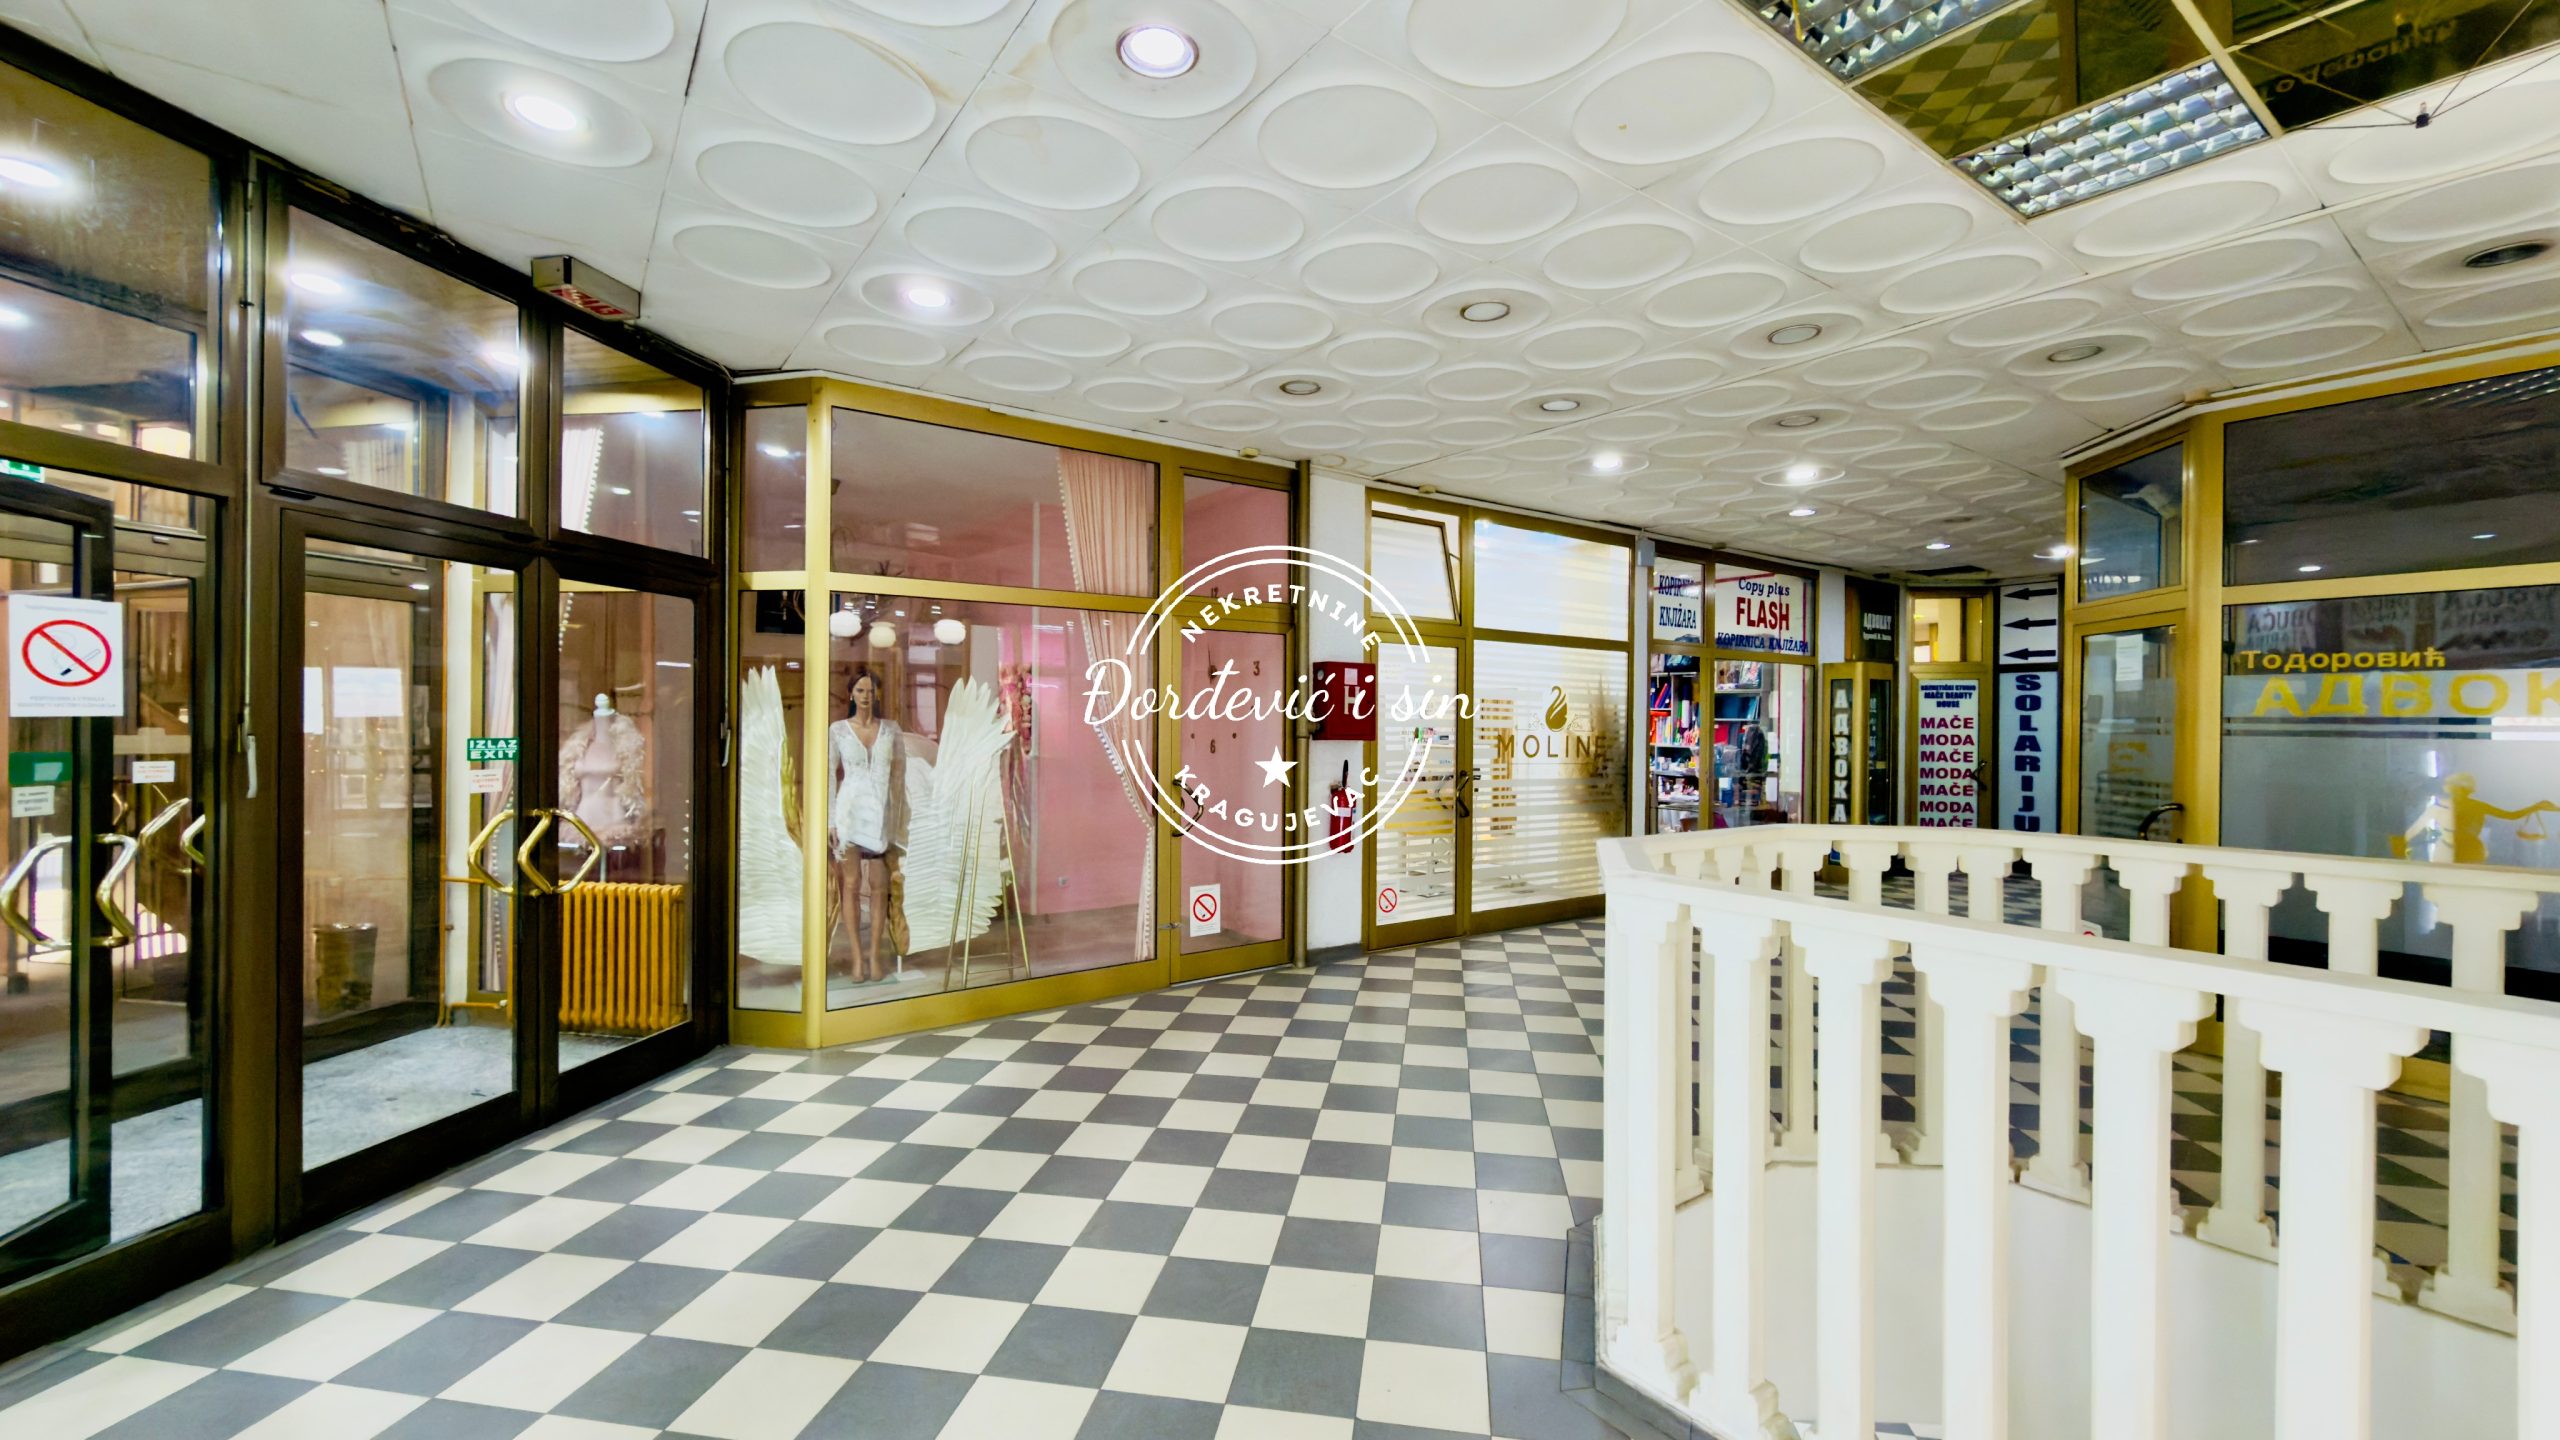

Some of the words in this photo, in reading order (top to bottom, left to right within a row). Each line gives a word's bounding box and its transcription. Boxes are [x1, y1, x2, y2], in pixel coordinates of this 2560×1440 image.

[1658, 575, 1699, 599] KOPIRNI
[1738, 577, 1764, 597] Copy
[1767, 582, 1790, 598] plus
[1658, 603, 1697, 629] KNJIŽARA
[1736, 597, 1790, 631] FLASH
[1716, 632, 1765, 649] KOPIRNICA
[1768, 636, 1809, 653] KNJIŽARA
[2241, 646, 2446, 673] Тодоровић
[1253, 661, 1261, 676] 3
[1924, 691, 1944, 699] MAČE
[1920, 715, 1974, 729] MAČE
[469, 739, 518, 749] IZLAZ
[1210, 739, 1216, 754] 6
[1498, 734, 1607, 760] MOLINE
[1920, 734, 1975, 746] MODA
[470, 749, 516, 759] EXIT
[1920, 749, 1974, 763] MAČE
[1920, 768, 1974, 779] MODA
[1920, 782, 1974, 797] MAČE
[1920, 801, 1974, 814] MODA
[1920, 816, 1974, 828] MAČE
